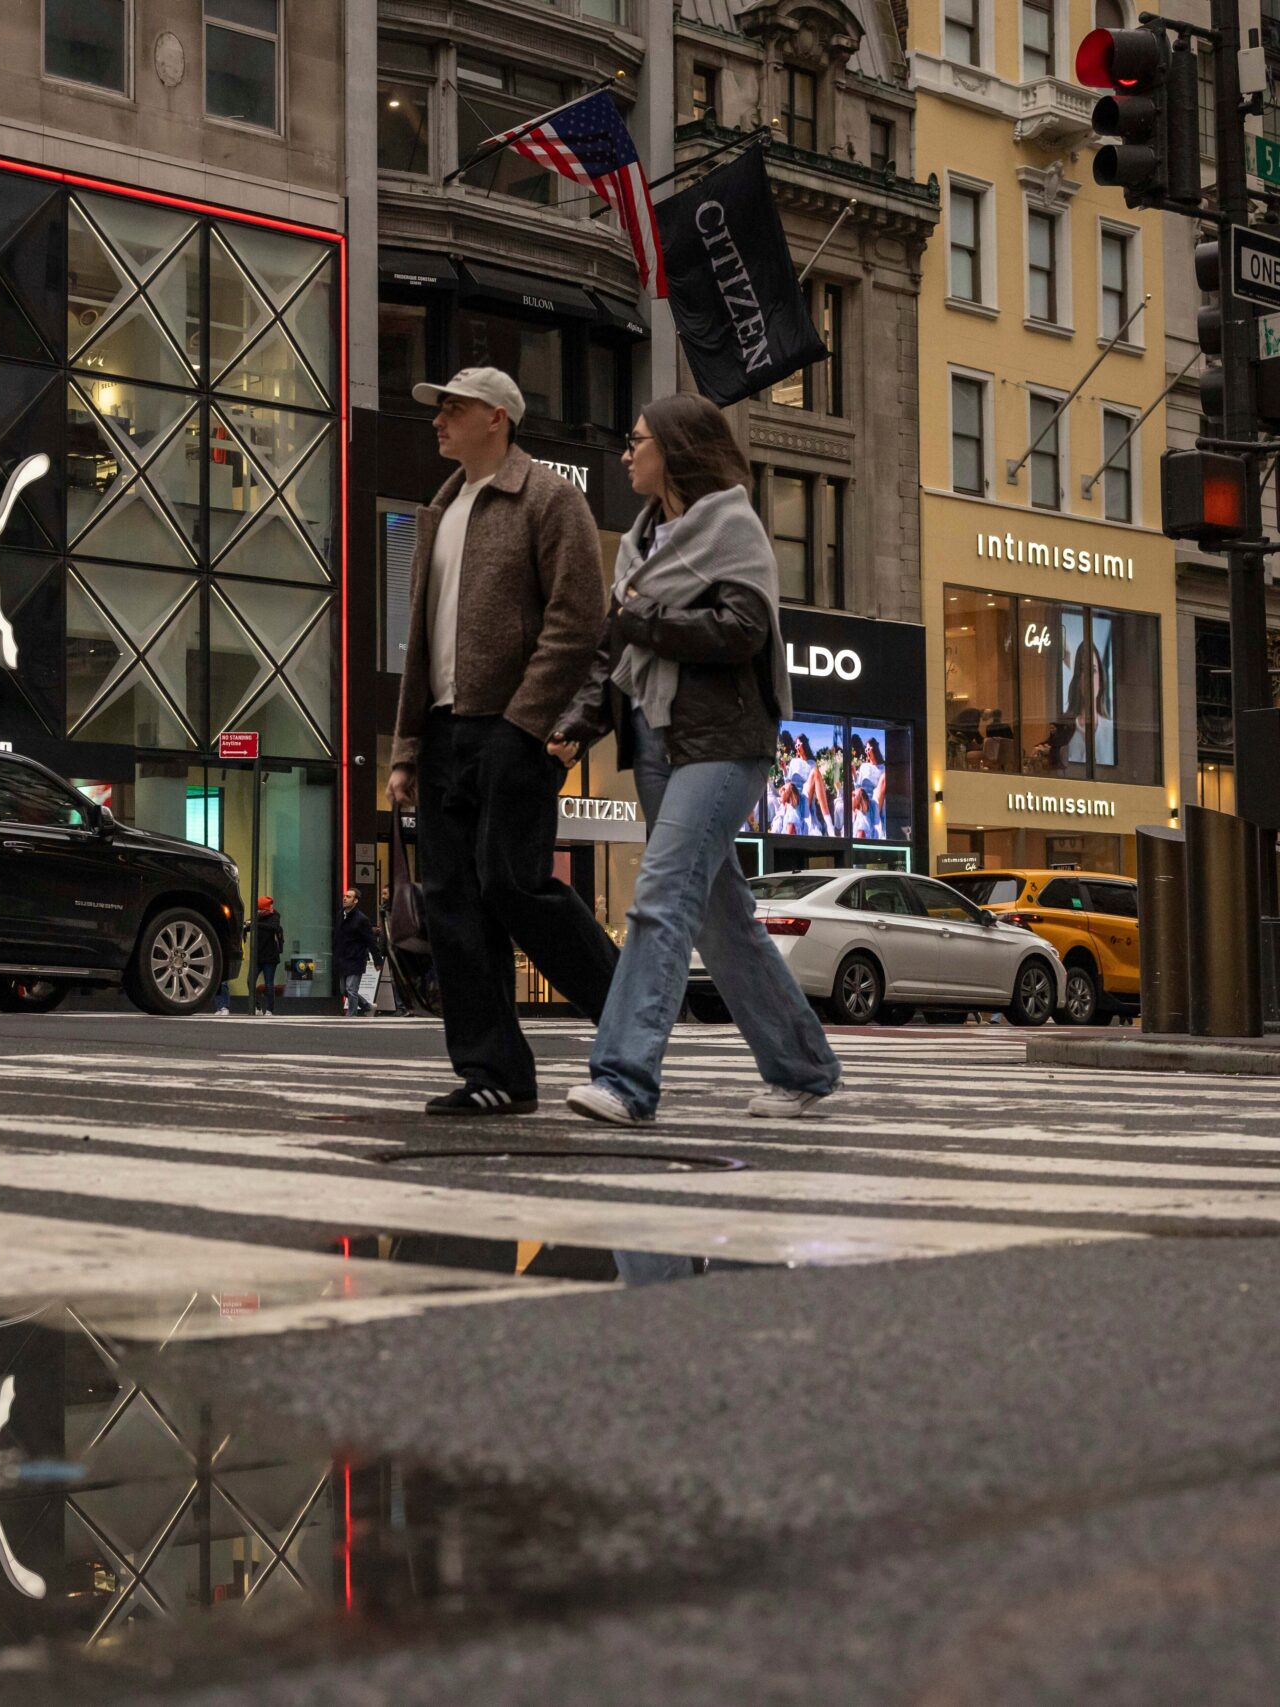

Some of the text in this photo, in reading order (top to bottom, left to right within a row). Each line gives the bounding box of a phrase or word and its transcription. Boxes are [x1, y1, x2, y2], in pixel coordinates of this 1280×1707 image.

[1250, 253, 1280, 287] ONE
[695, 200, 773, 374] CITIZEN
[523, 295, 554, 311] BULOVA
[626, 322, 643, 334] Alpina
[977, 532, 1133, 580] intimissimi
[561, 797, 638, 821] CITIZEN
[1008, 792, 1115, 817] intimissimi
